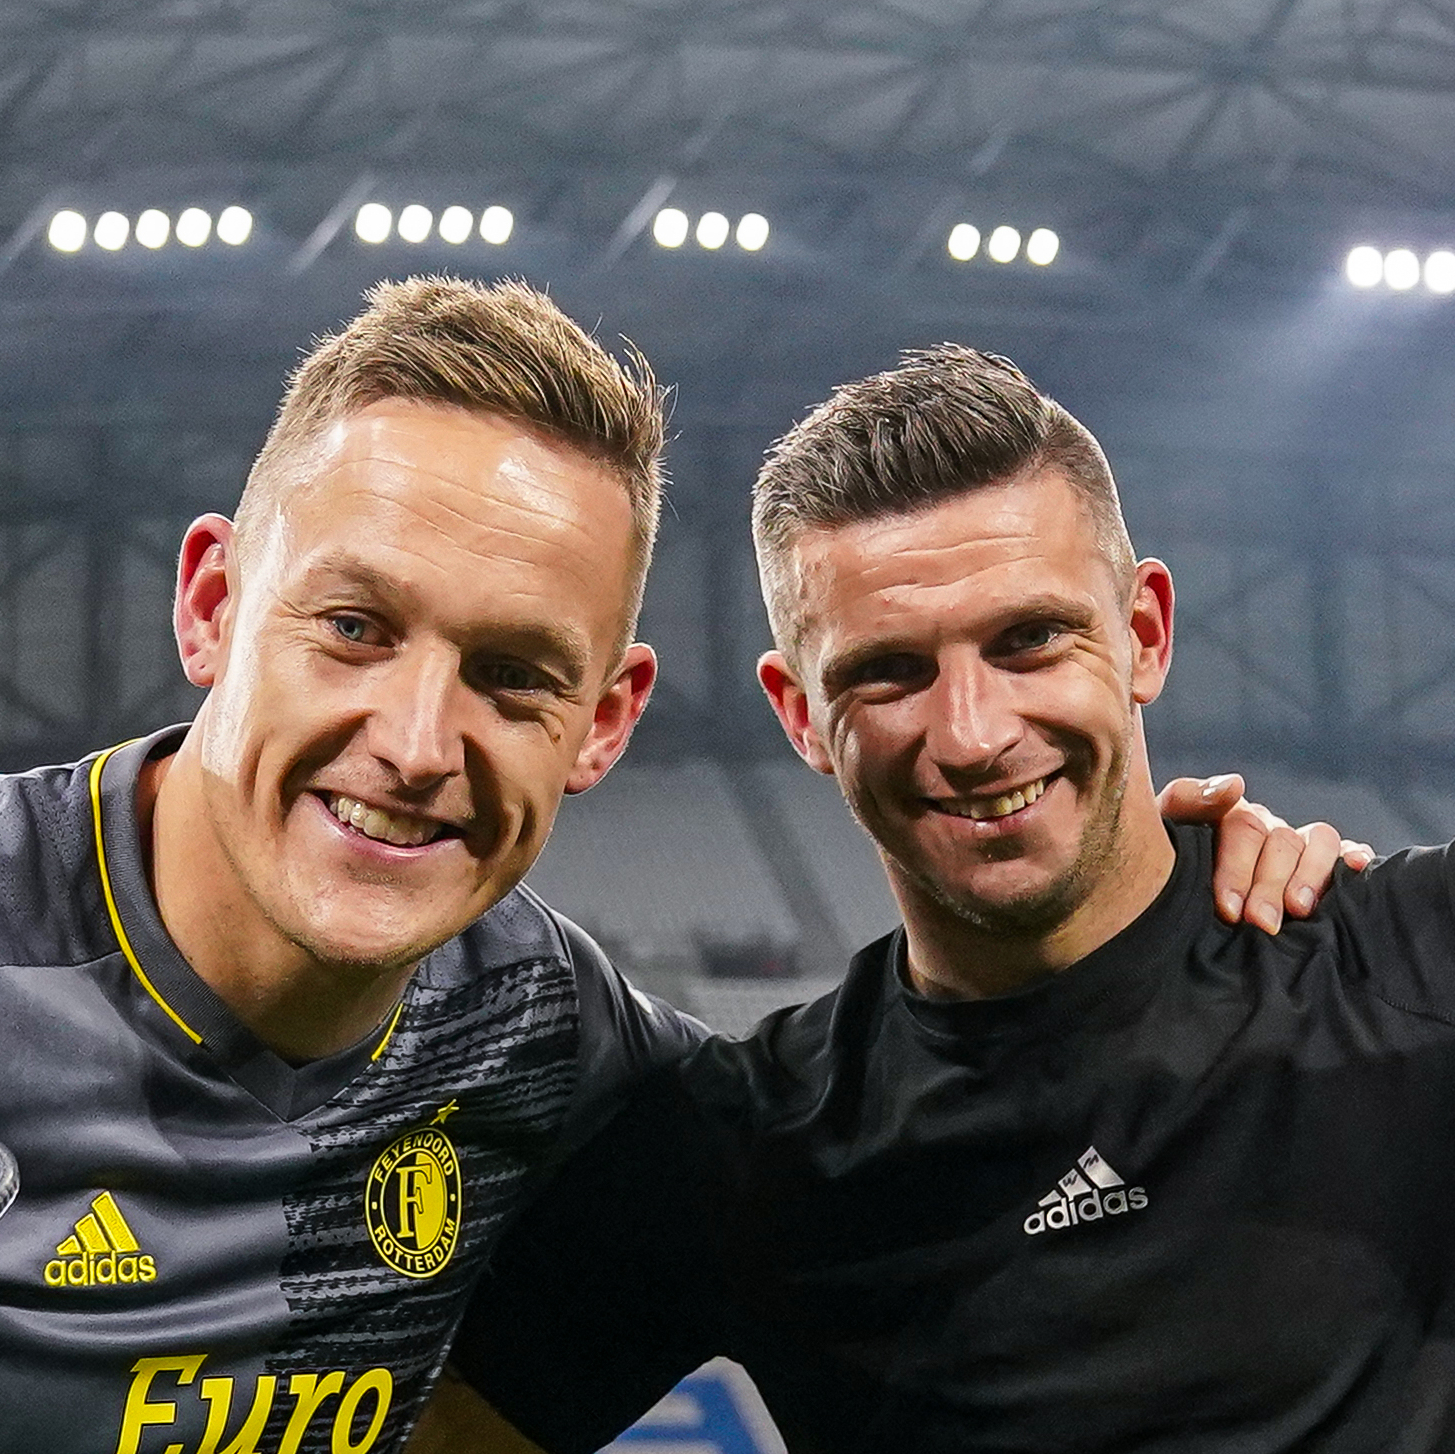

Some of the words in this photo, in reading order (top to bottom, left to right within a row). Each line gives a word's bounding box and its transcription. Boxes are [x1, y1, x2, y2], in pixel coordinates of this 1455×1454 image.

[374, 1132, 455, 1184] FEYENOORD
[1023, 1186, 1149, 1236] adidas
[44, 1249, 157, 1287] adidas
[373, 1217, 456, 1273] ROTTERDAM
